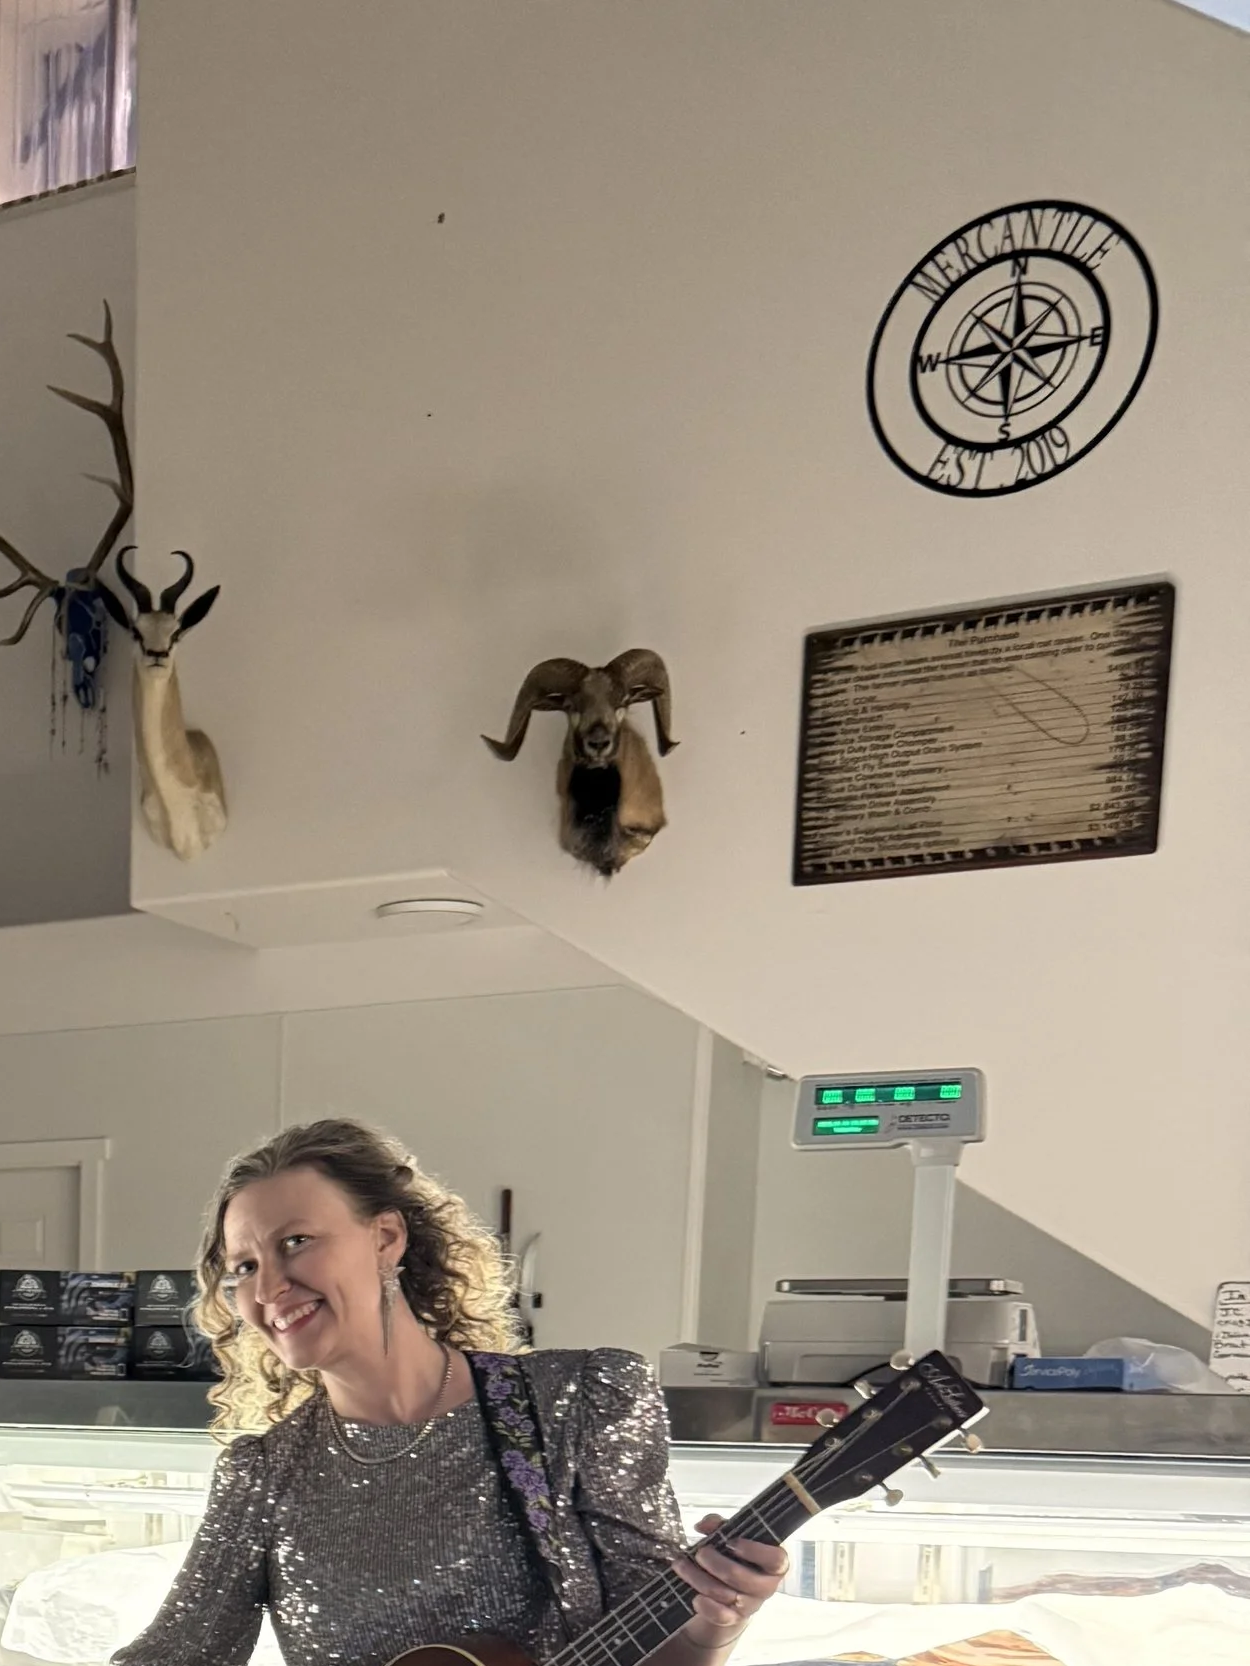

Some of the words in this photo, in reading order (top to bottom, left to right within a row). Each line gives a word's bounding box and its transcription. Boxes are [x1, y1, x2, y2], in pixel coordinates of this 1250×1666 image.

[910, 207, 1121, 304] MERCANTILE
[1010, 256, 1029, 277] N
[1089, 326, 1105, 347] E
[916, 352, 942, 373] W
[998, 421, 1011, 442] S
[1010, 425, 1071, 485] 2019
[898, 1113, 951, 1123] DETECTO
